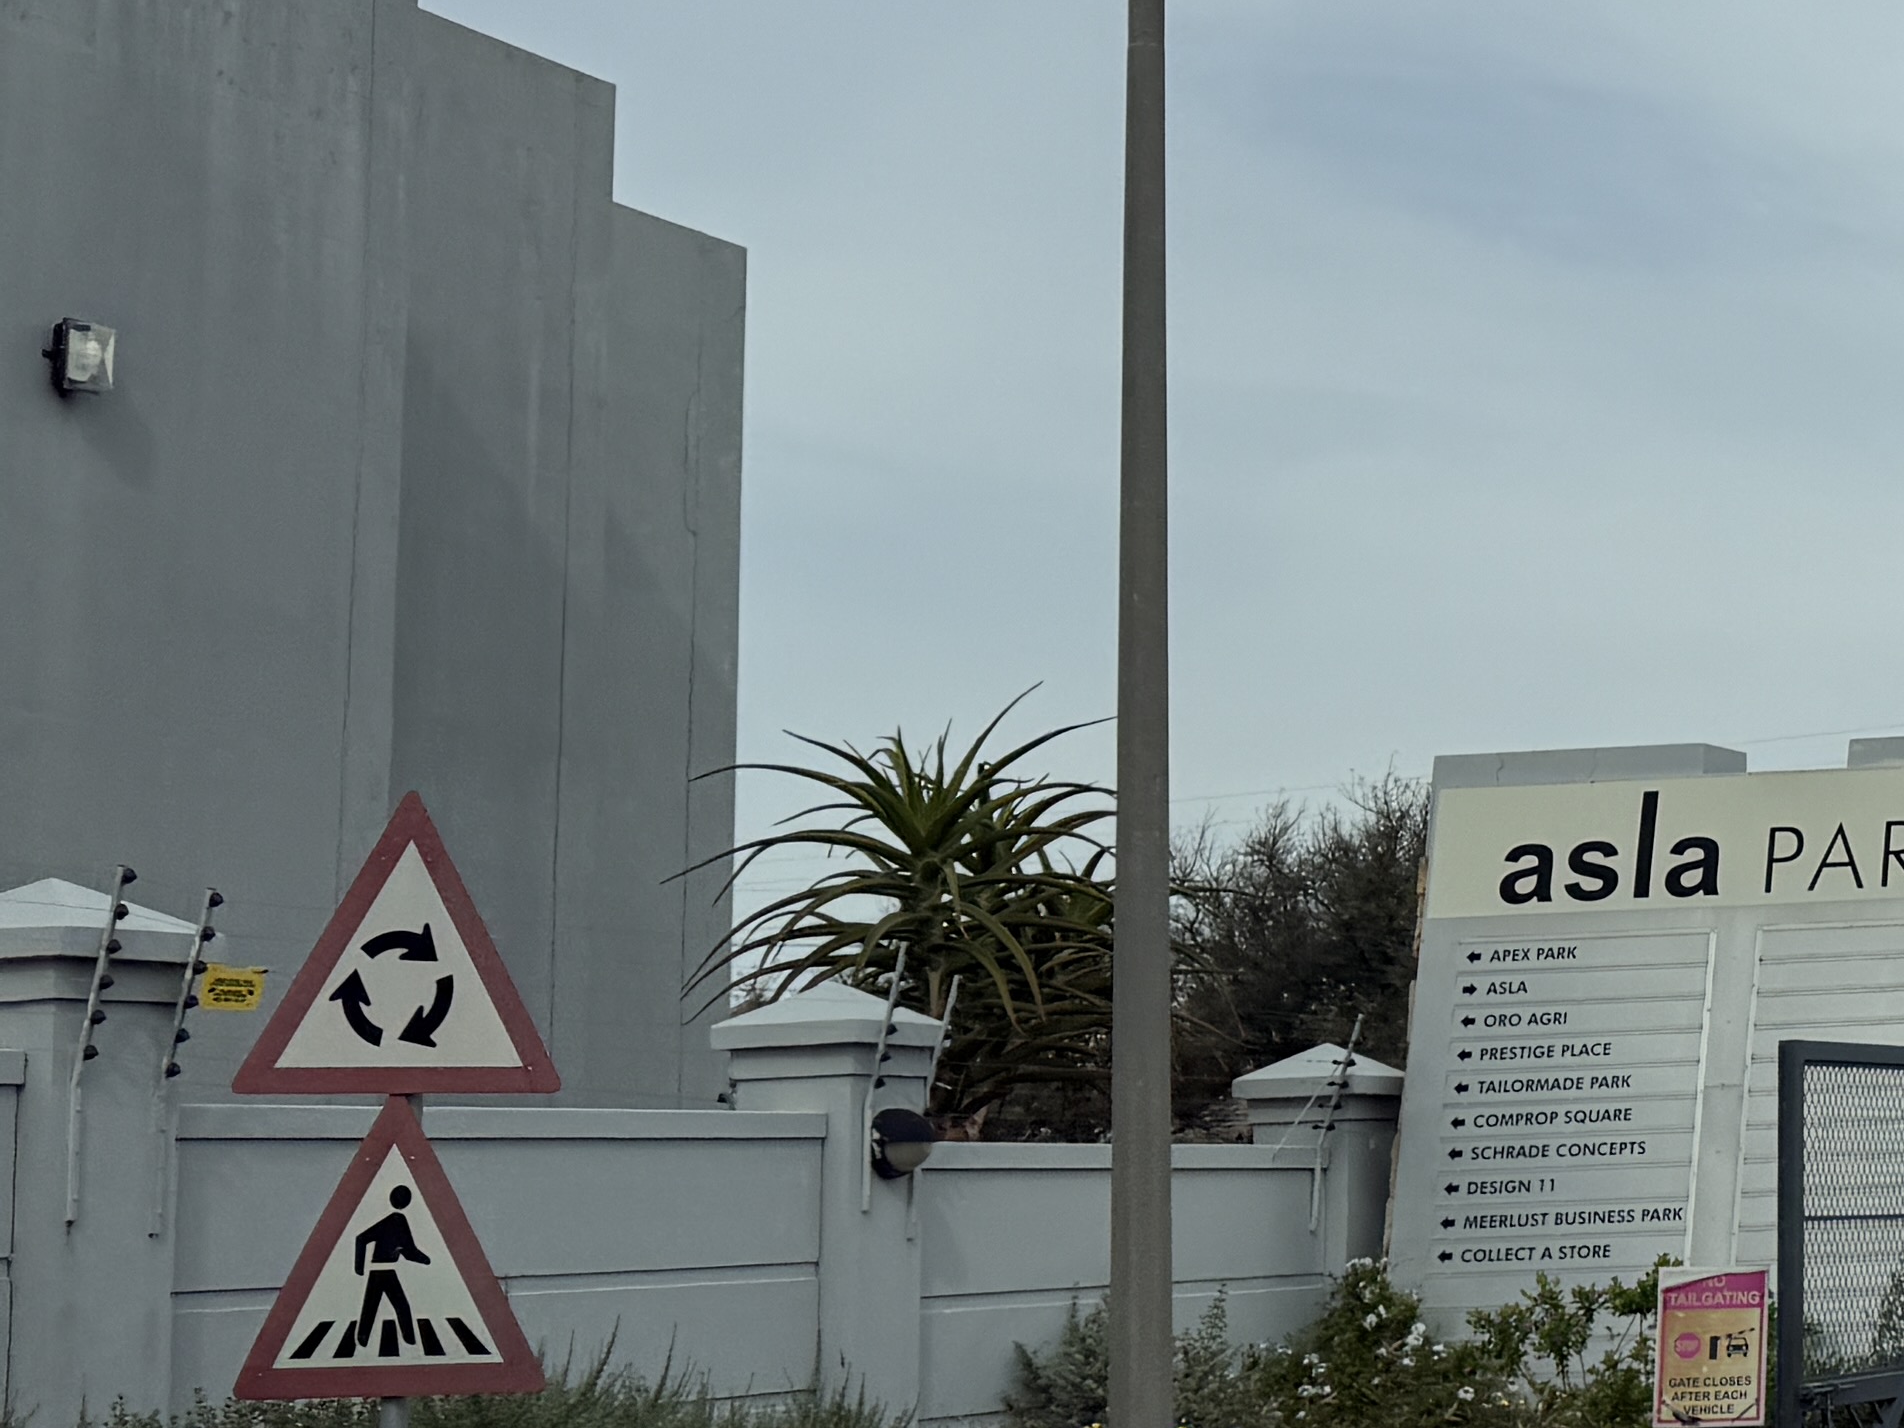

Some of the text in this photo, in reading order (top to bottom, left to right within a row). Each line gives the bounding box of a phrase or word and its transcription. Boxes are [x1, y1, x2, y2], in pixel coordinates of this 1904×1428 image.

[1499, 790, 1720, 905] asla
[1489, 946, 1578, 963] APEX PARK
[1486, 980, 1528, 996] ASLA
[1483, 1012, 1568, 1027] ORO AGRI
[1479, 1042, 1612, 1061] PRESTIGE PLACE
[1477, 1074, 1632, 1094] TAILORMADE PARK
[1473, 1108, 1633, 1129] COMPROP SQUARE
[1470, 1141, 1647, 1160] SCHRADE CONCEPTS
[1467, 1178, 1555, 1195] DESIGN 11
[1463, 1207, 1683, 1230] MEERLUST BUSINESS PARK
[1461, 1244, 1611, 1263] COLLECT A STORE
[1669, 1291, 1761, 1305] TAILGATING
[1669, 1375, 1752, 1389] GATE CLOSES
[1671, 1389, 1748, 1402] AFTER EACH
[1683, 1403, 1735, 1416] VEHICLE
